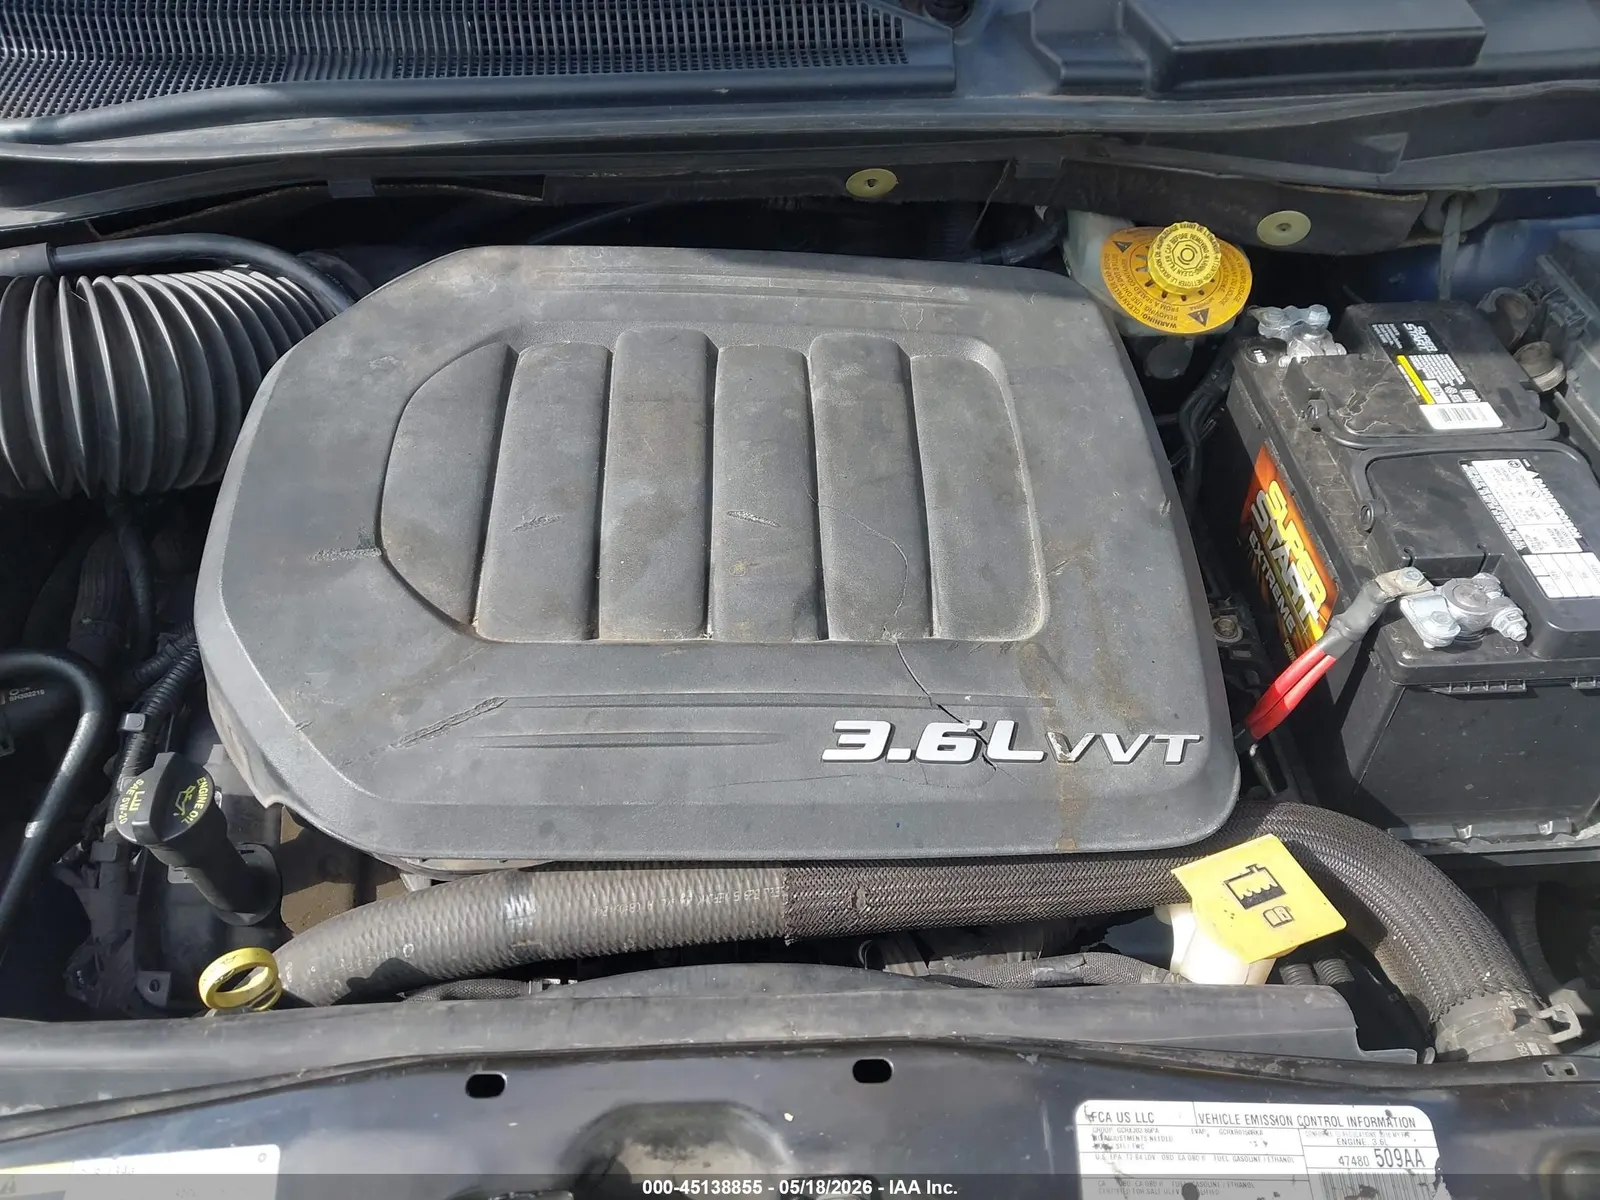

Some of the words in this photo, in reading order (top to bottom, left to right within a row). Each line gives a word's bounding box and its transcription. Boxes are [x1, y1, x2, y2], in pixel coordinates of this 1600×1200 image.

[1251, 490, 1320, 624] START
[1266, 480, 1327, 613] SUPER
[1248, 530, 1296, 634] EXTREME
[821, 719, 1047, 765] 3.6L
[1045, 731, 1204, 765] VVT
[126, 778, 145, 796] SAE
[196, 776, 209, 810] ENGINE
[118, 797, 131, 825] 5W-20
[180, 811, 199, 825] OIL
[1091, 1111, 1112, 1123] FCA
[1116, 1111, 1131, 1123] US
[1135, 1112, 1155, 1124] LLC
[1198, 1113, 1241, 1125] VEHICLE
[1245, 1114, 1293, 1127] EMISSION
[1297, 1115, 1344, 1128] CONTROL
[1347, 1116, 1416, 1128] INFORMATION
[1372, 1138, 1388, 1146] 3.6L
[1338, 1155, 1370, 1167] 47480
[1373, 1148, 1426, 1168] 509AA
